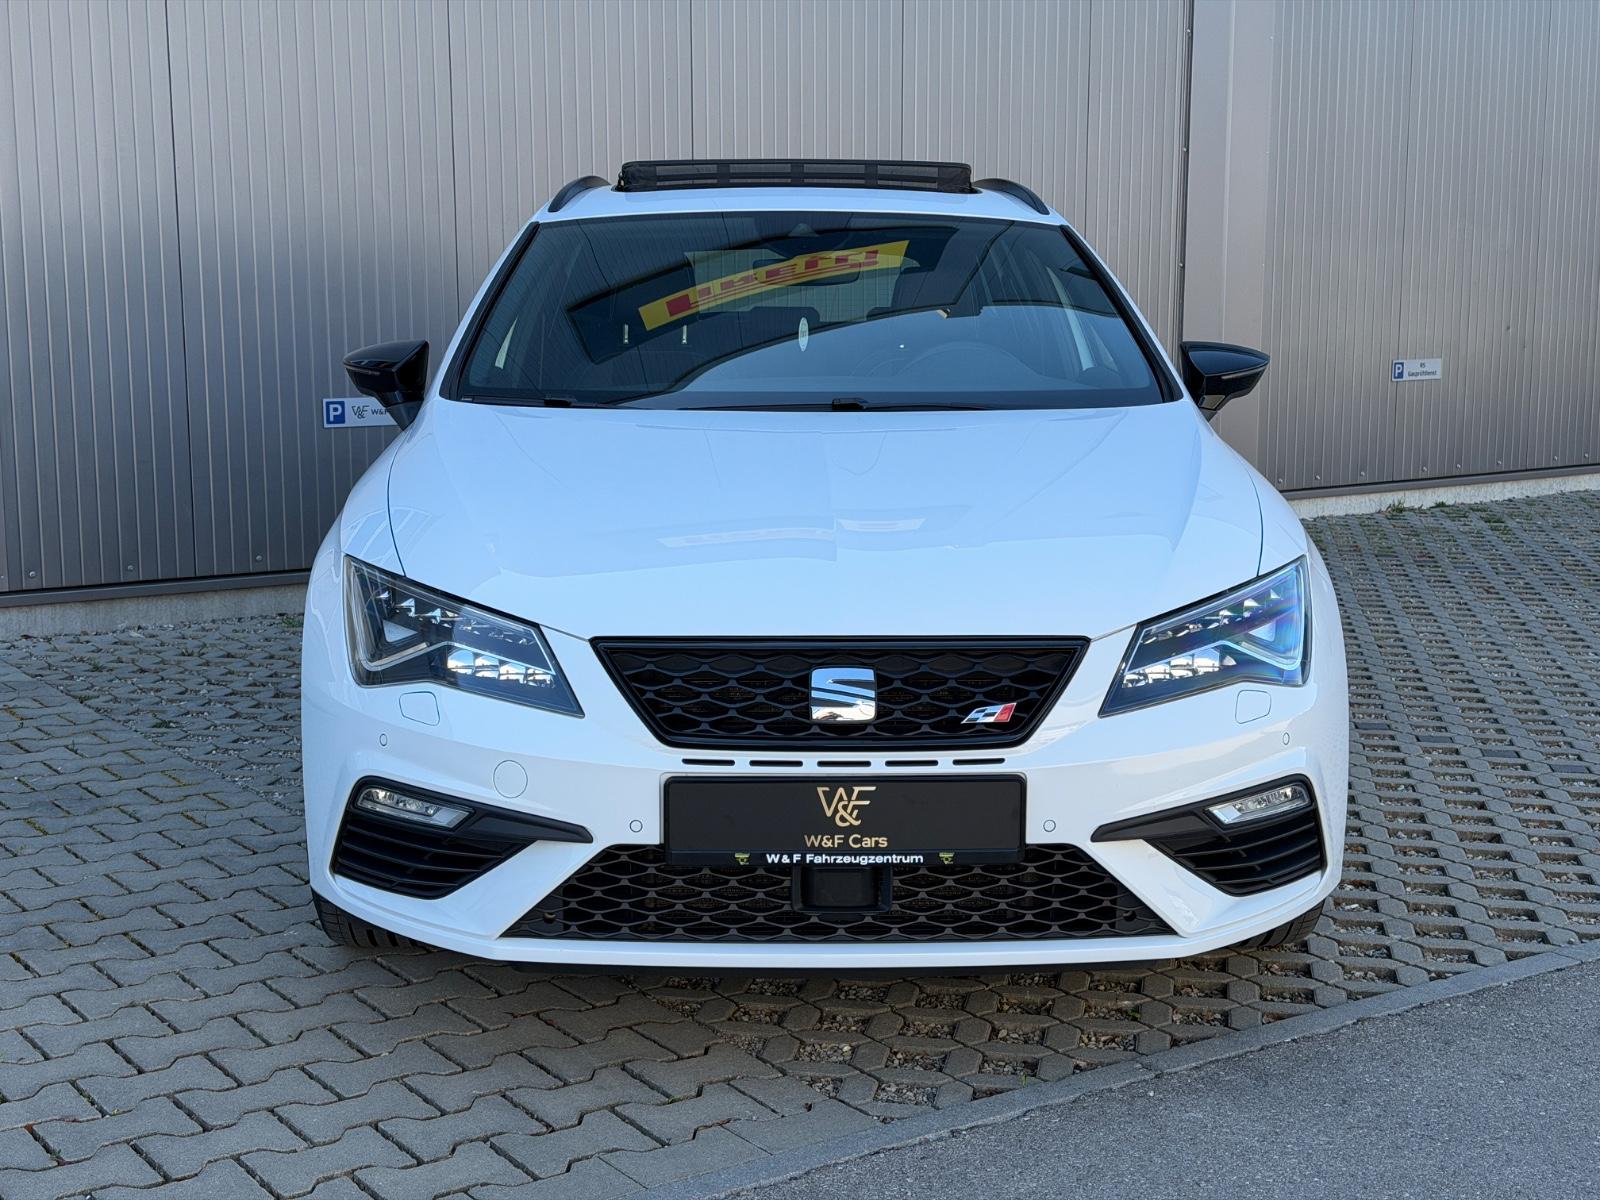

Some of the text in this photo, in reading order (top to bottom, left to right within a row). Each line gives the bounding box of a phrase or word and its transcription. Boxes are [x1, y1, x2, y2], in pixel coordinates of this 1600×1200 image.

[1395, 364, 1403, 377] P
[329, 404, 342, 421] P
[804, 834, 888, 848] W&F Cars
[806, 853, 924, 866] Fahrzeugzentrum
